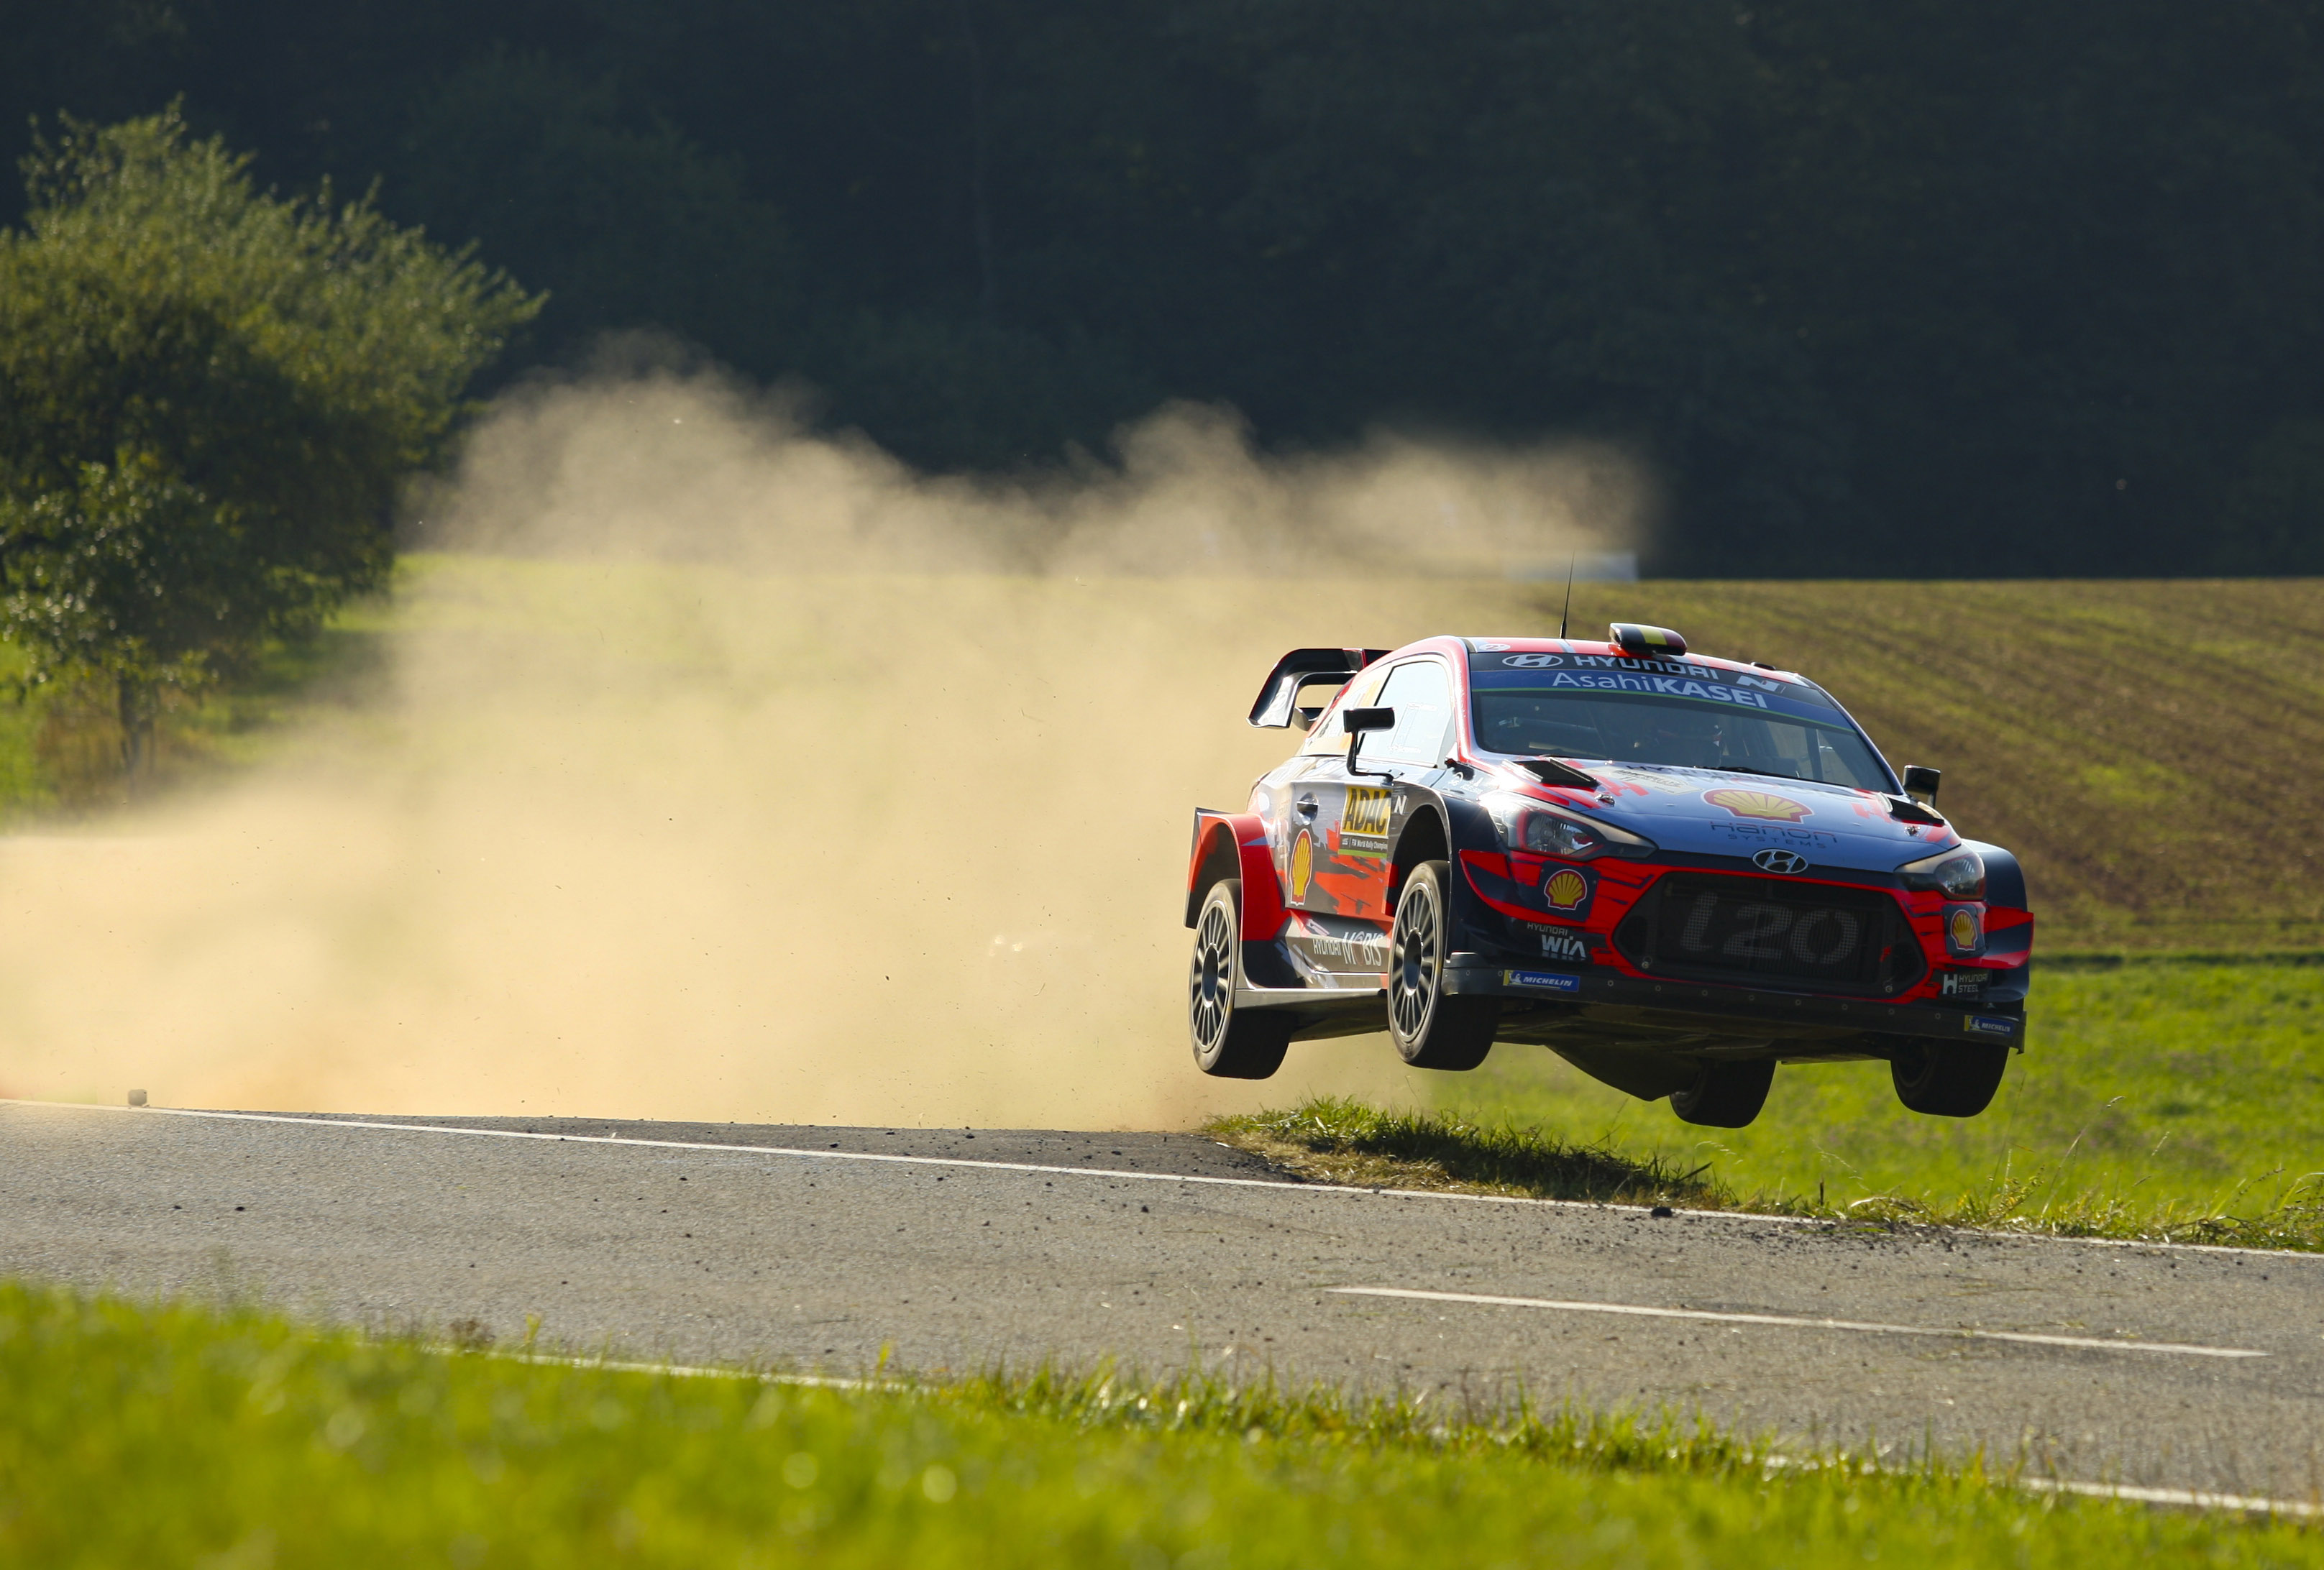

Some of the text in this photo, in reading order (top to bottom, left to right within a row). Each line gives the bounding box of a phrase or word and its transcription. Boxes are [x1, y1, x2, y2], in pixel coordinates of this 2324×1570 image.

[1573, 655, 1719, 679] HYUNDAI
[1552, 671, 1768, 710] AsahiKASEI
[1343, 788, 1391, 834] ADAC
[1728, 834, 1826, 850] SYSTEMS
[1527, 922, 1568, 937] HYUNDAI
[1312, 931, 1383, 967] HYUNDAI MOBIS
[1522, 975, 1573, 988] MICHELIN
[1957, 983, 1980, 993] STEEL
[1980, 1022, 2011, 1033] MICHELIN
